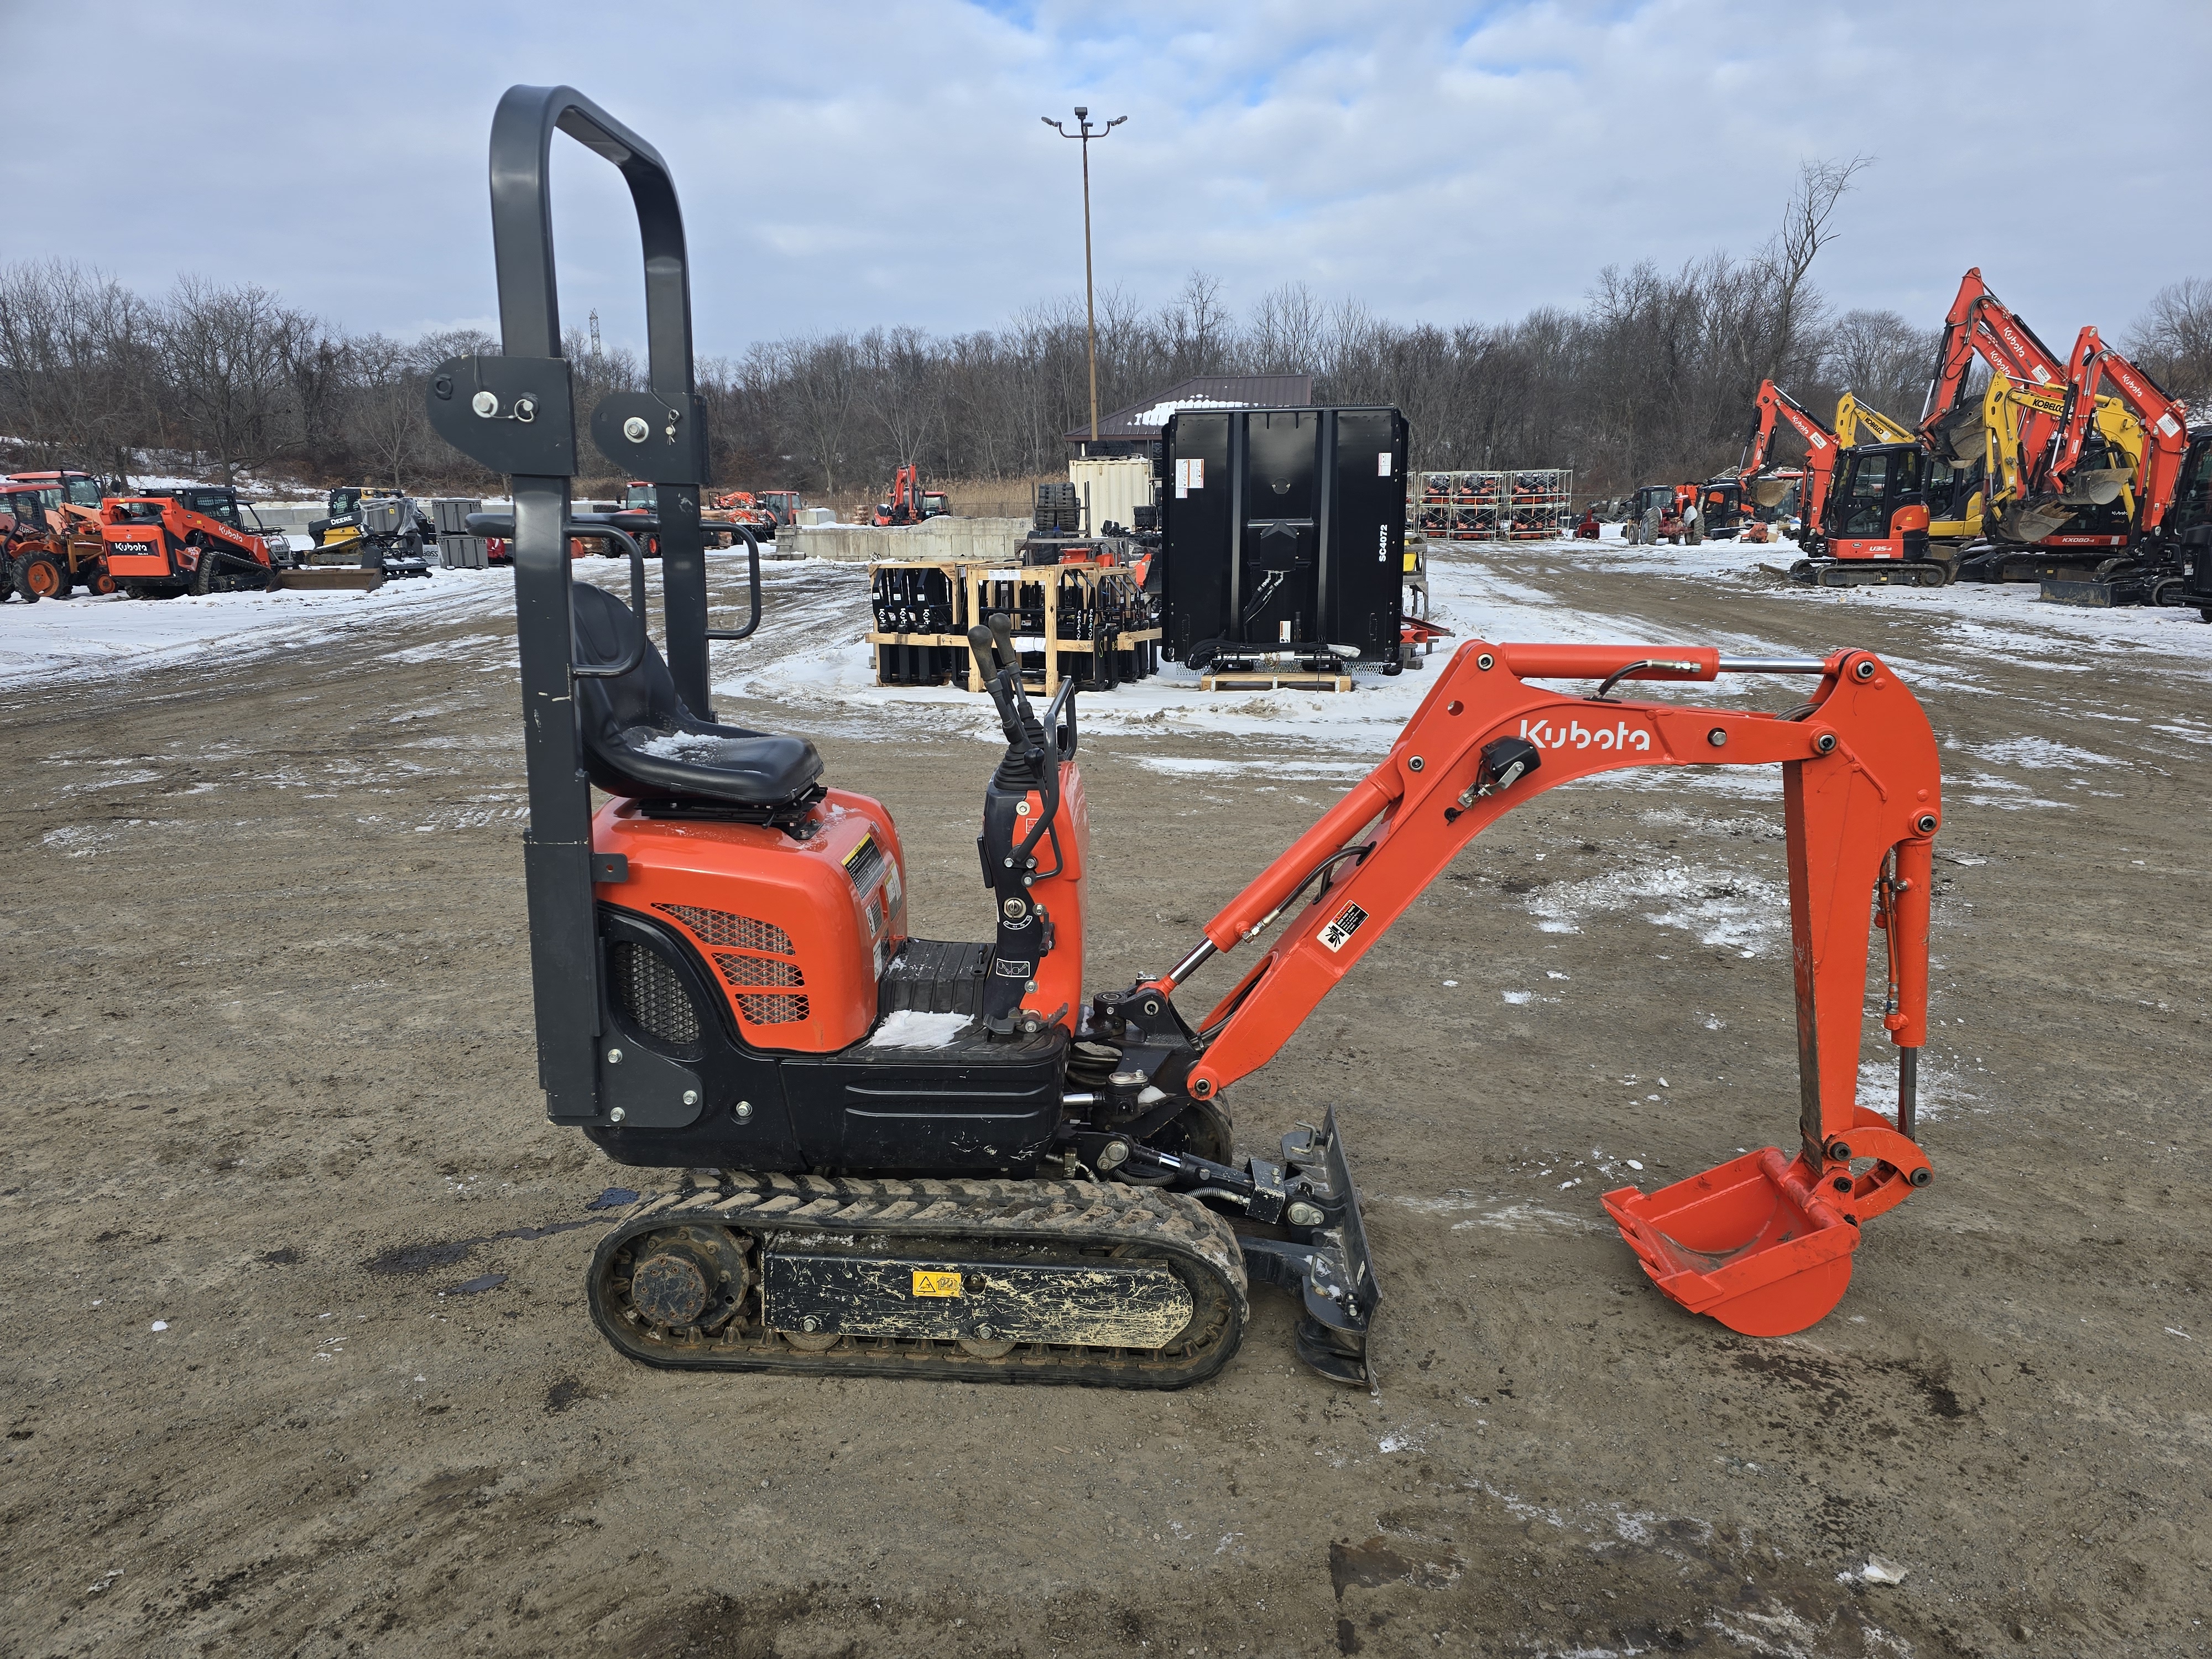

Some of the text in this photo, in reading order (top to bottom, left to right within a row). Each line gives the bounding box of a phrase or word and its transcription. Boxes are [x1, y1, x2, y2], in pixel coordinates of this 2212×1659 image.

[2004, 326, 2025, 357] Kubota
[1990, 350, 2010, 375] Kubota
[2122, 373, 2143, 398] Kubota
[1792, 415, 1809, 435] Kubota
[1864, 417, 1884, 435] KOBELCO
[330, 515, 353, 525] DEERE
[218, 525, 243, 542] Kubota
[1379, 524, 1387, 562] SC4072
[114, 542, 148, 551] Kubota
[1519, 719, 1650, 750] Kubota
